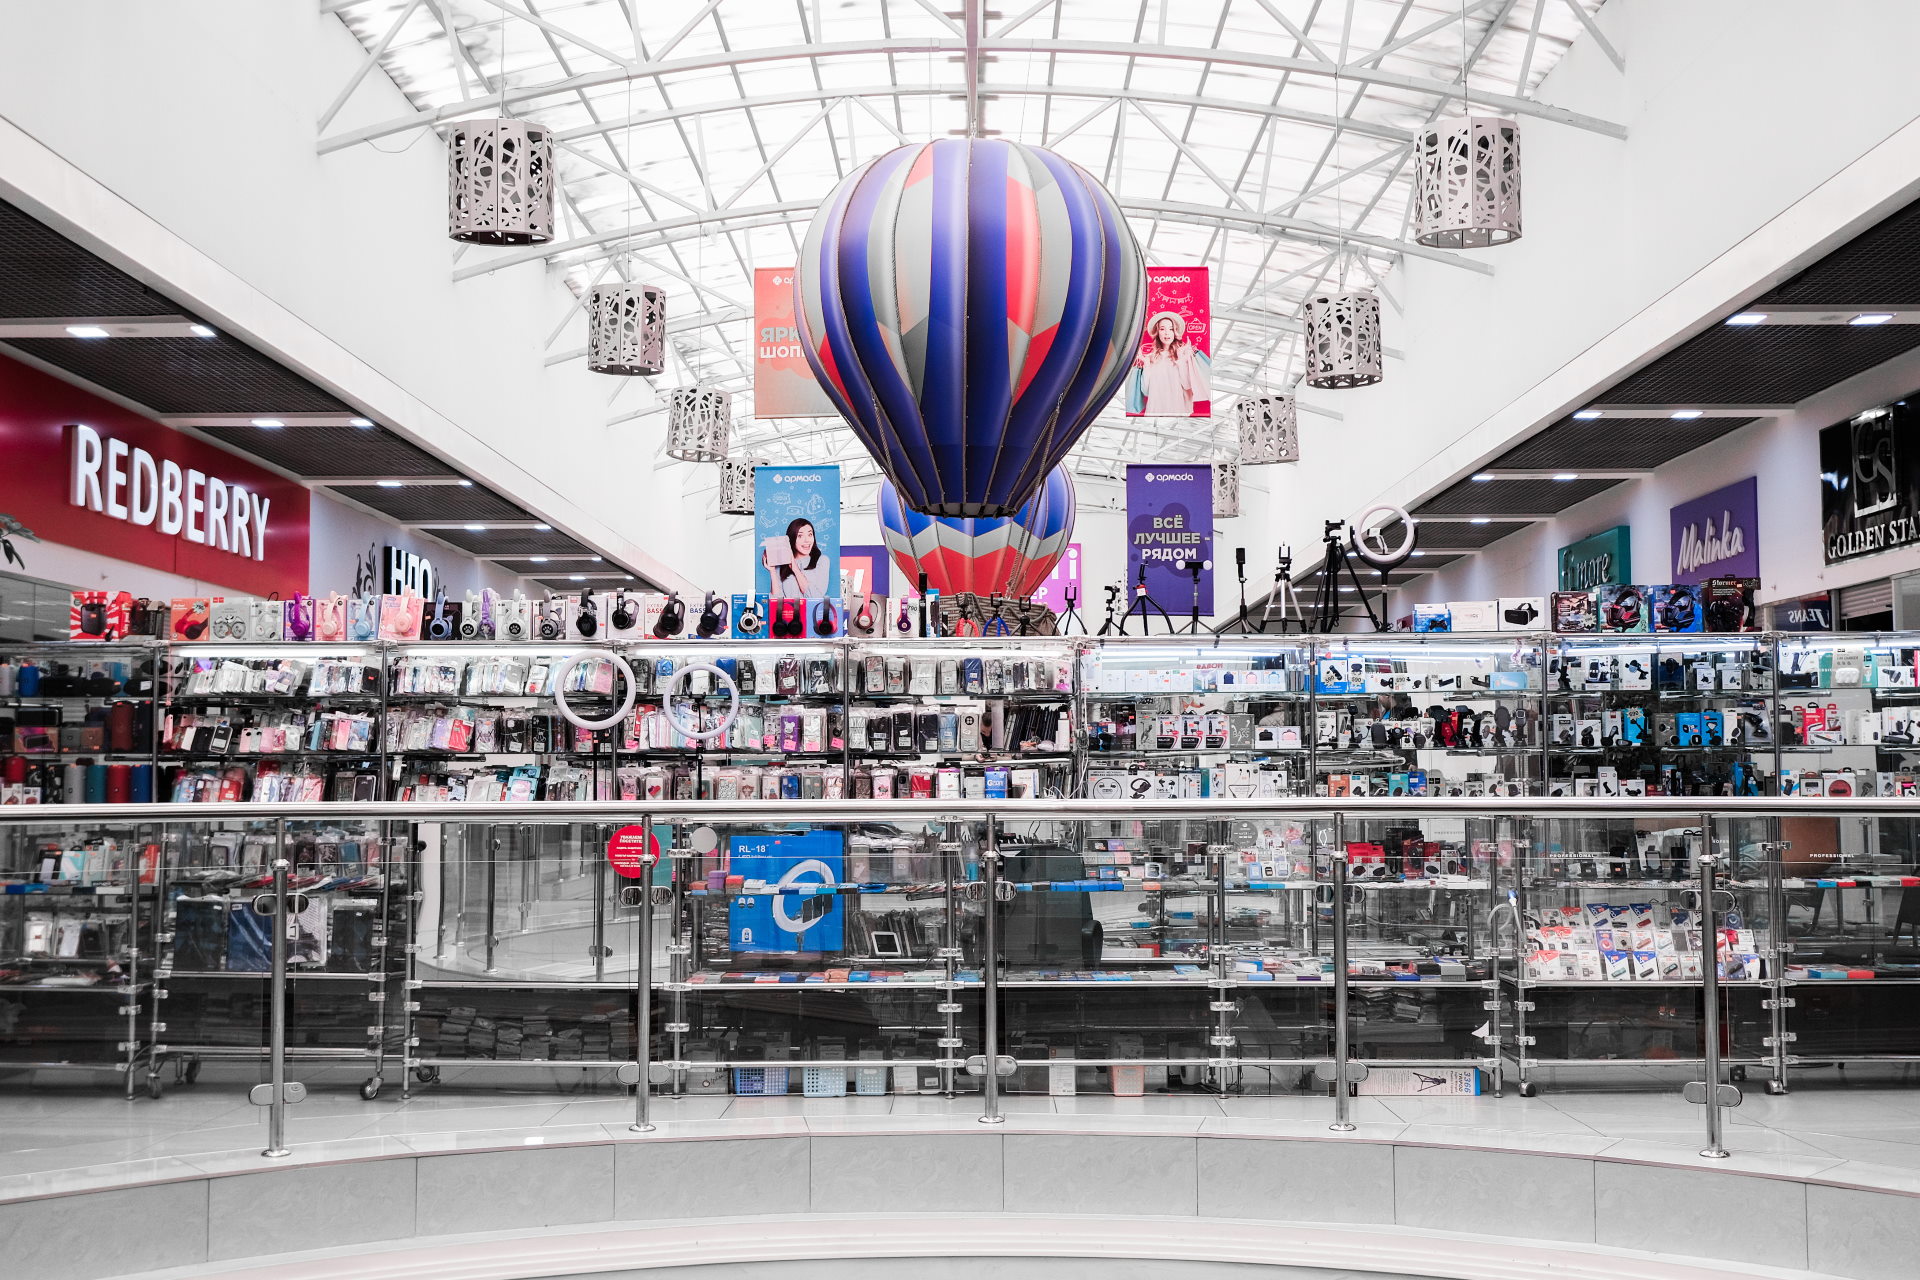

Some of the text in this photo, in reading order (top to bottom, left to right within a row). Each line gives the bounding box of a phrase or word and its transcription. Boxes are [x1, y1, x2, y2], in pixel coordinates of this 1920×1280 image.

[760, 327, 801, 342] ЯРК
[760, 346, 805, 359] ШОП
[70, 424, 271, 562] REDBERRY
[1153, 514, 1184, 529] ВСЁ
[1133, 532, 1201, 545] ЛУЧШЕЕ
[1676, 509, 1745, 575] Malinka
[1827, 510, 1920, 559] GOLDEN STA
[1141, 548, 1197, 561] РЯДОМ
[1463, 1071, 1472, 1094] 3366
